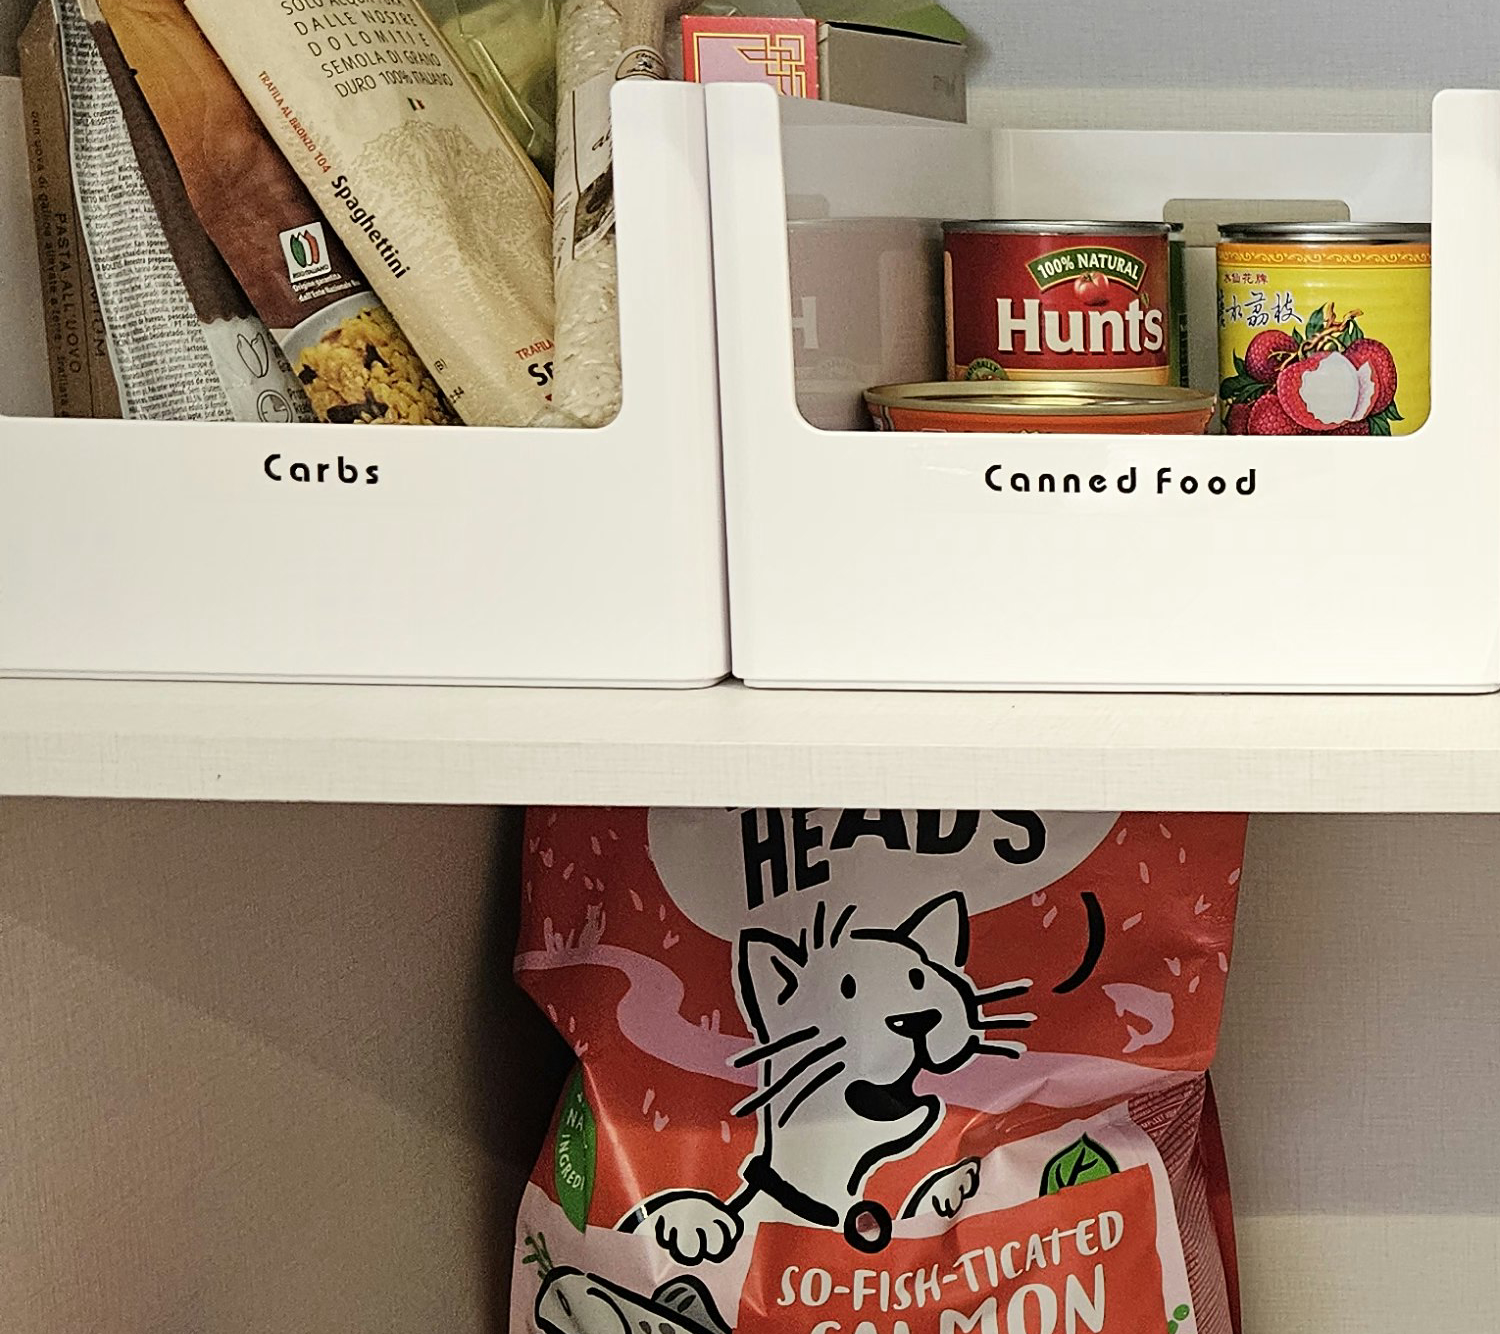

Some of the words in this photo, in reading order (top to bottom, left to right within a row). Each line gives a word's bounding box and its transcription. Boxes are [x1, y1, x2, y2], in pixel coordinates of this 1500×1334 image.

[293, 12, 357, 36] DALLE
[360, 9, 418, 27] NOSTRE
[307, 30, 416, 57] DOLOMITI
[418, 32, 430, 47] E
[321, 50, 387, 79] SEMOLA
[386, 49, 404, 64] DI
[402, 50, 442, 67] GRANO
[334, 74, 377, 98] DURO
[378, 69, 414, 86] 100%
[258, 70, 285, 107] TRAFILA
[280, 105, 294, 119] AL
[288, 116, 317, 153] BRONZO
[314, 151, 332, 174] 104
[54, 212, 71, 273] PASTA
[330, 174, 411, 280] Spaghettini
[1036, 254, 1075, 280] 100%
[1077, 252, 1140, 281] NATURAL
[263, 453, 380, 485] Carbs
[985, 464, 1137, 495] Canned
[1156, 467, 1257, 497] Food
[558, 1133, 585, 1191] INGREDI
[776, 1210, 1125, 1312] SO-FISH-TICATED
